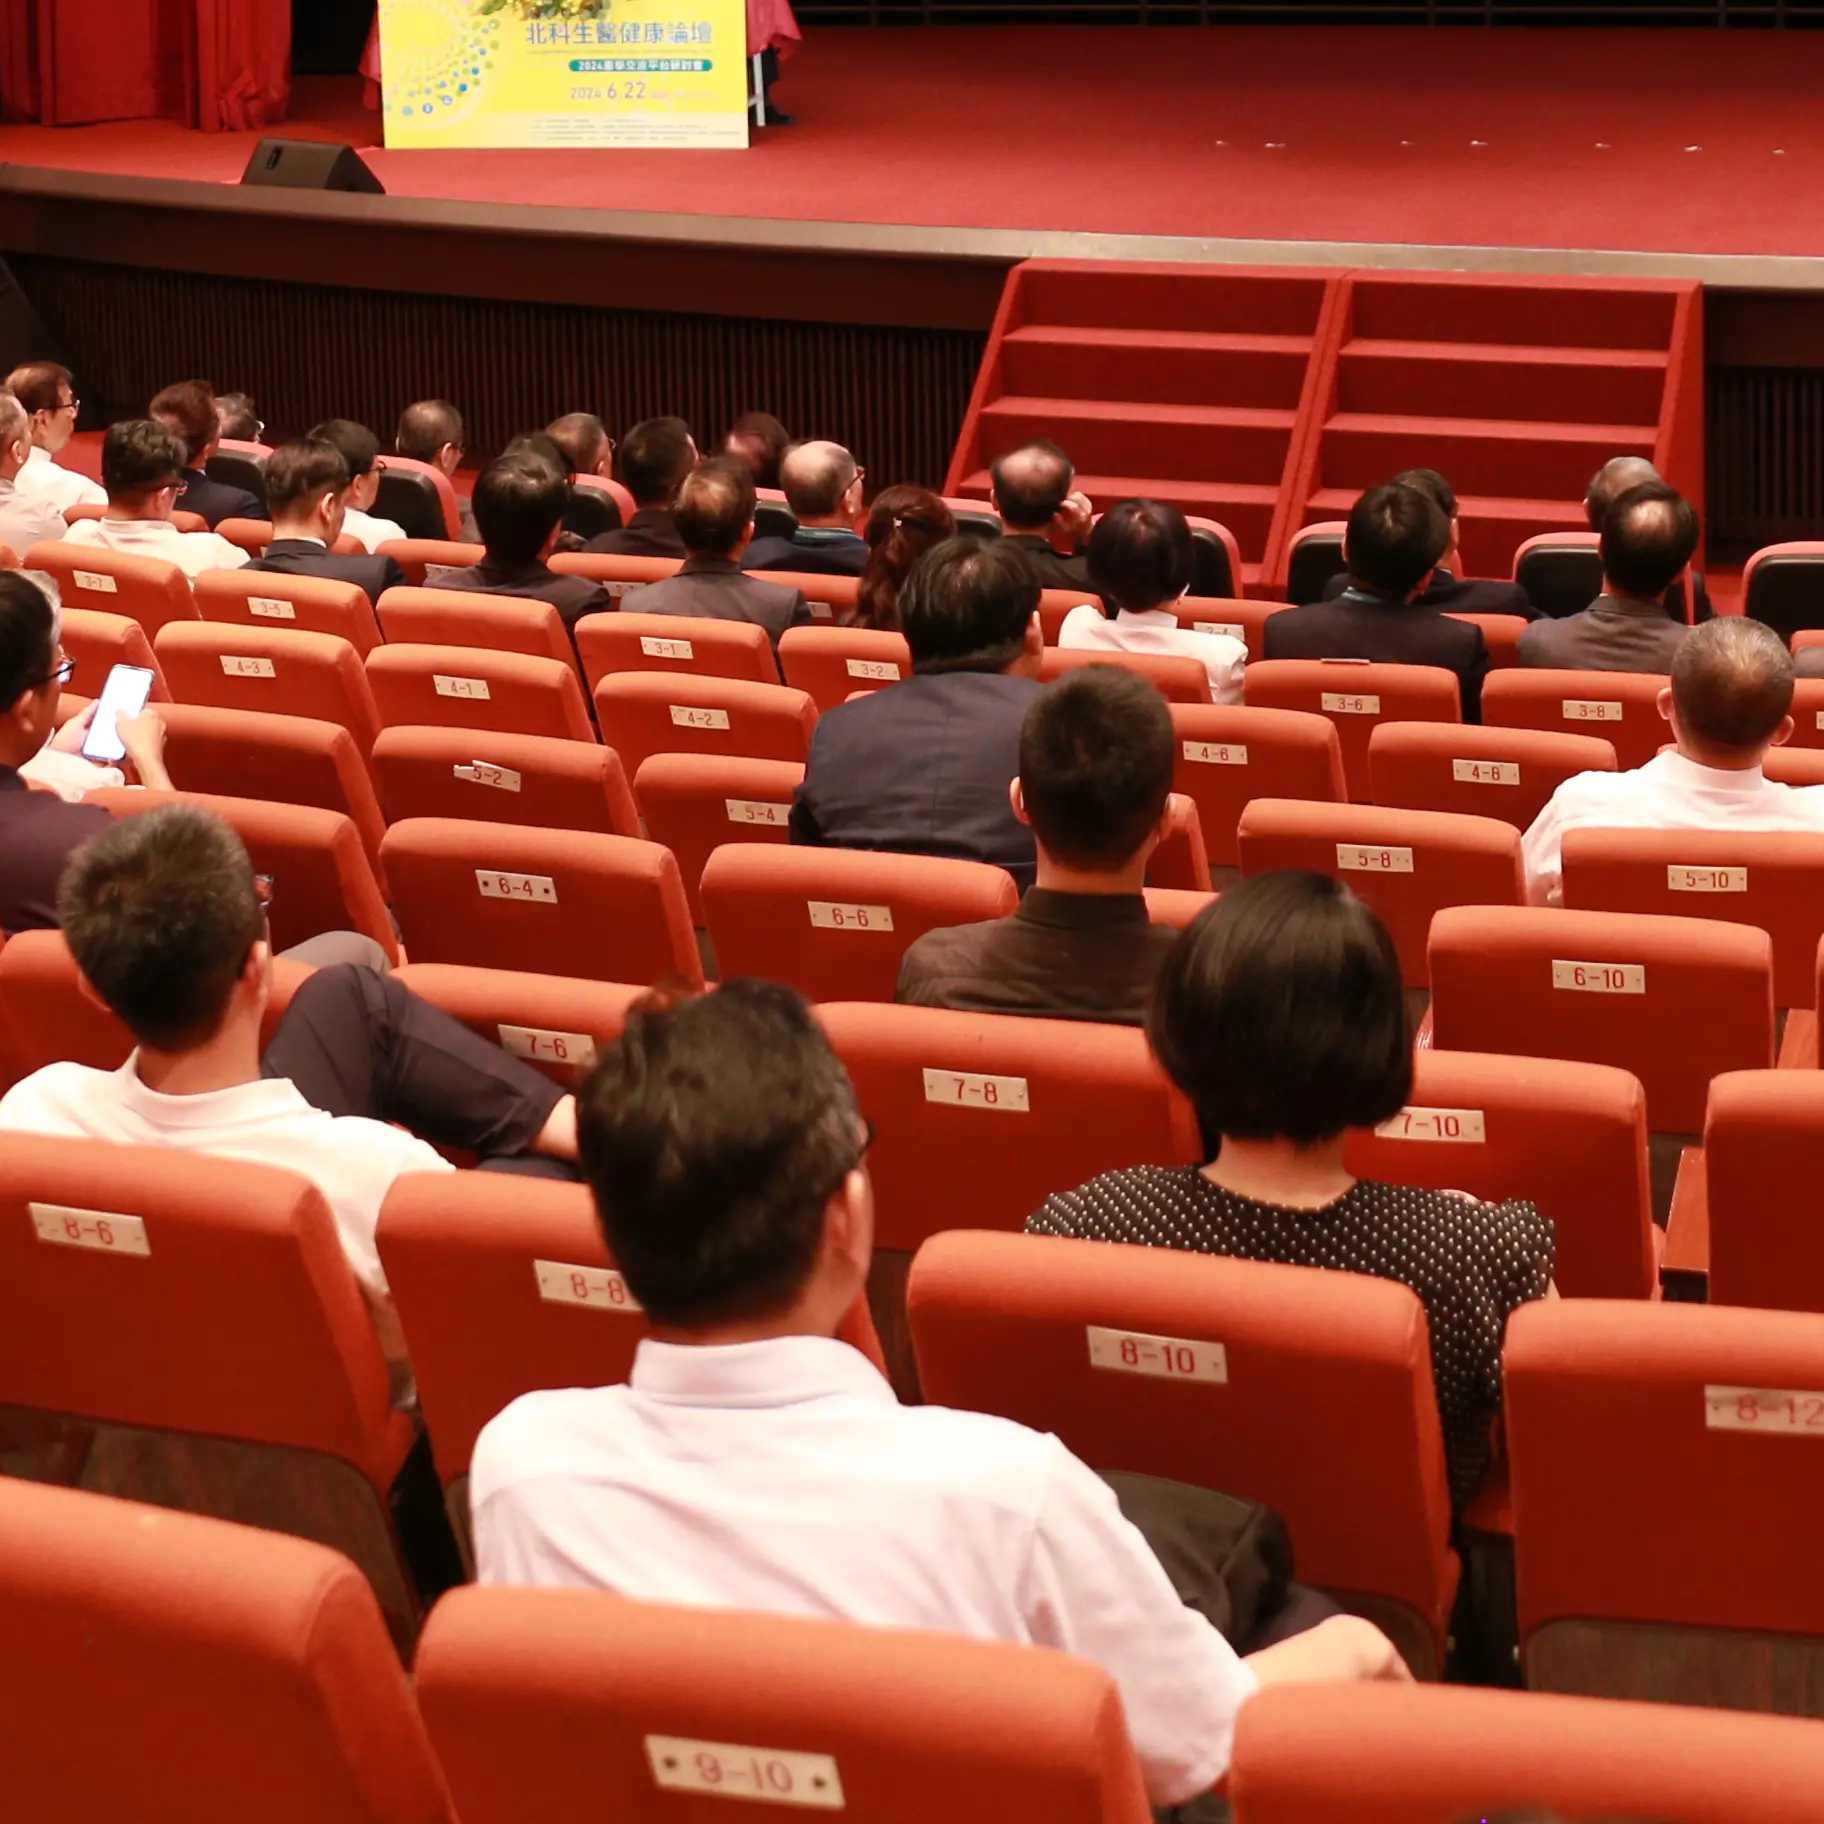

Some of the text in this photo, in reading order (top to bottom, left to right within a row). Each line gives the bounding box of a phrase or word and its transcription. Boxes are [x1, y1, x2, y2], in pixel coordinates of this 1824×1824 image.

[525, 21, 713, 45] 北科生醫健康論壇
[570, 86, 602, 100] 2024
[607, 80, 646, 99] 6.22
[259, 601, 282, 616] 3-5
[655, 640, 677, 655] 3-1
[235, 659, 261, 675] 4-3
[862, 662, 885, 678] 3-2
[449, 679, 473, 696] 4-1
[1337, 695, 1364, 712] 3-6
[1578, 701, 1607, 718] 3-8
[686, 709, 713, 728] 4-2
[1200, 744, 1230, 762] 4-6
[472, 764, 503, 786] 5-2
[1470, 764, 1501, 781] 4-8
[744, 803, 775, 822] 5-4
[1357, 849, 1392, 868] 5-8
[497, 876, 534, 897] 6-4
[1684, 869, 1730, 890] 5-10
[832, 907, 869, 928] 6-6
[1573, 967, 1626, 990] 6-10
[525, 1033, 568, 1059] 7-6
[951, 1078, 999, 1105] 7-8
[1398, 1112, 1460, 1139] 7-10
[63, 1216, 115, 1245] 8-6
[569, 1272, 626, 1304] 8-8
[1120, 1341, 1197, 1375] 8-10
